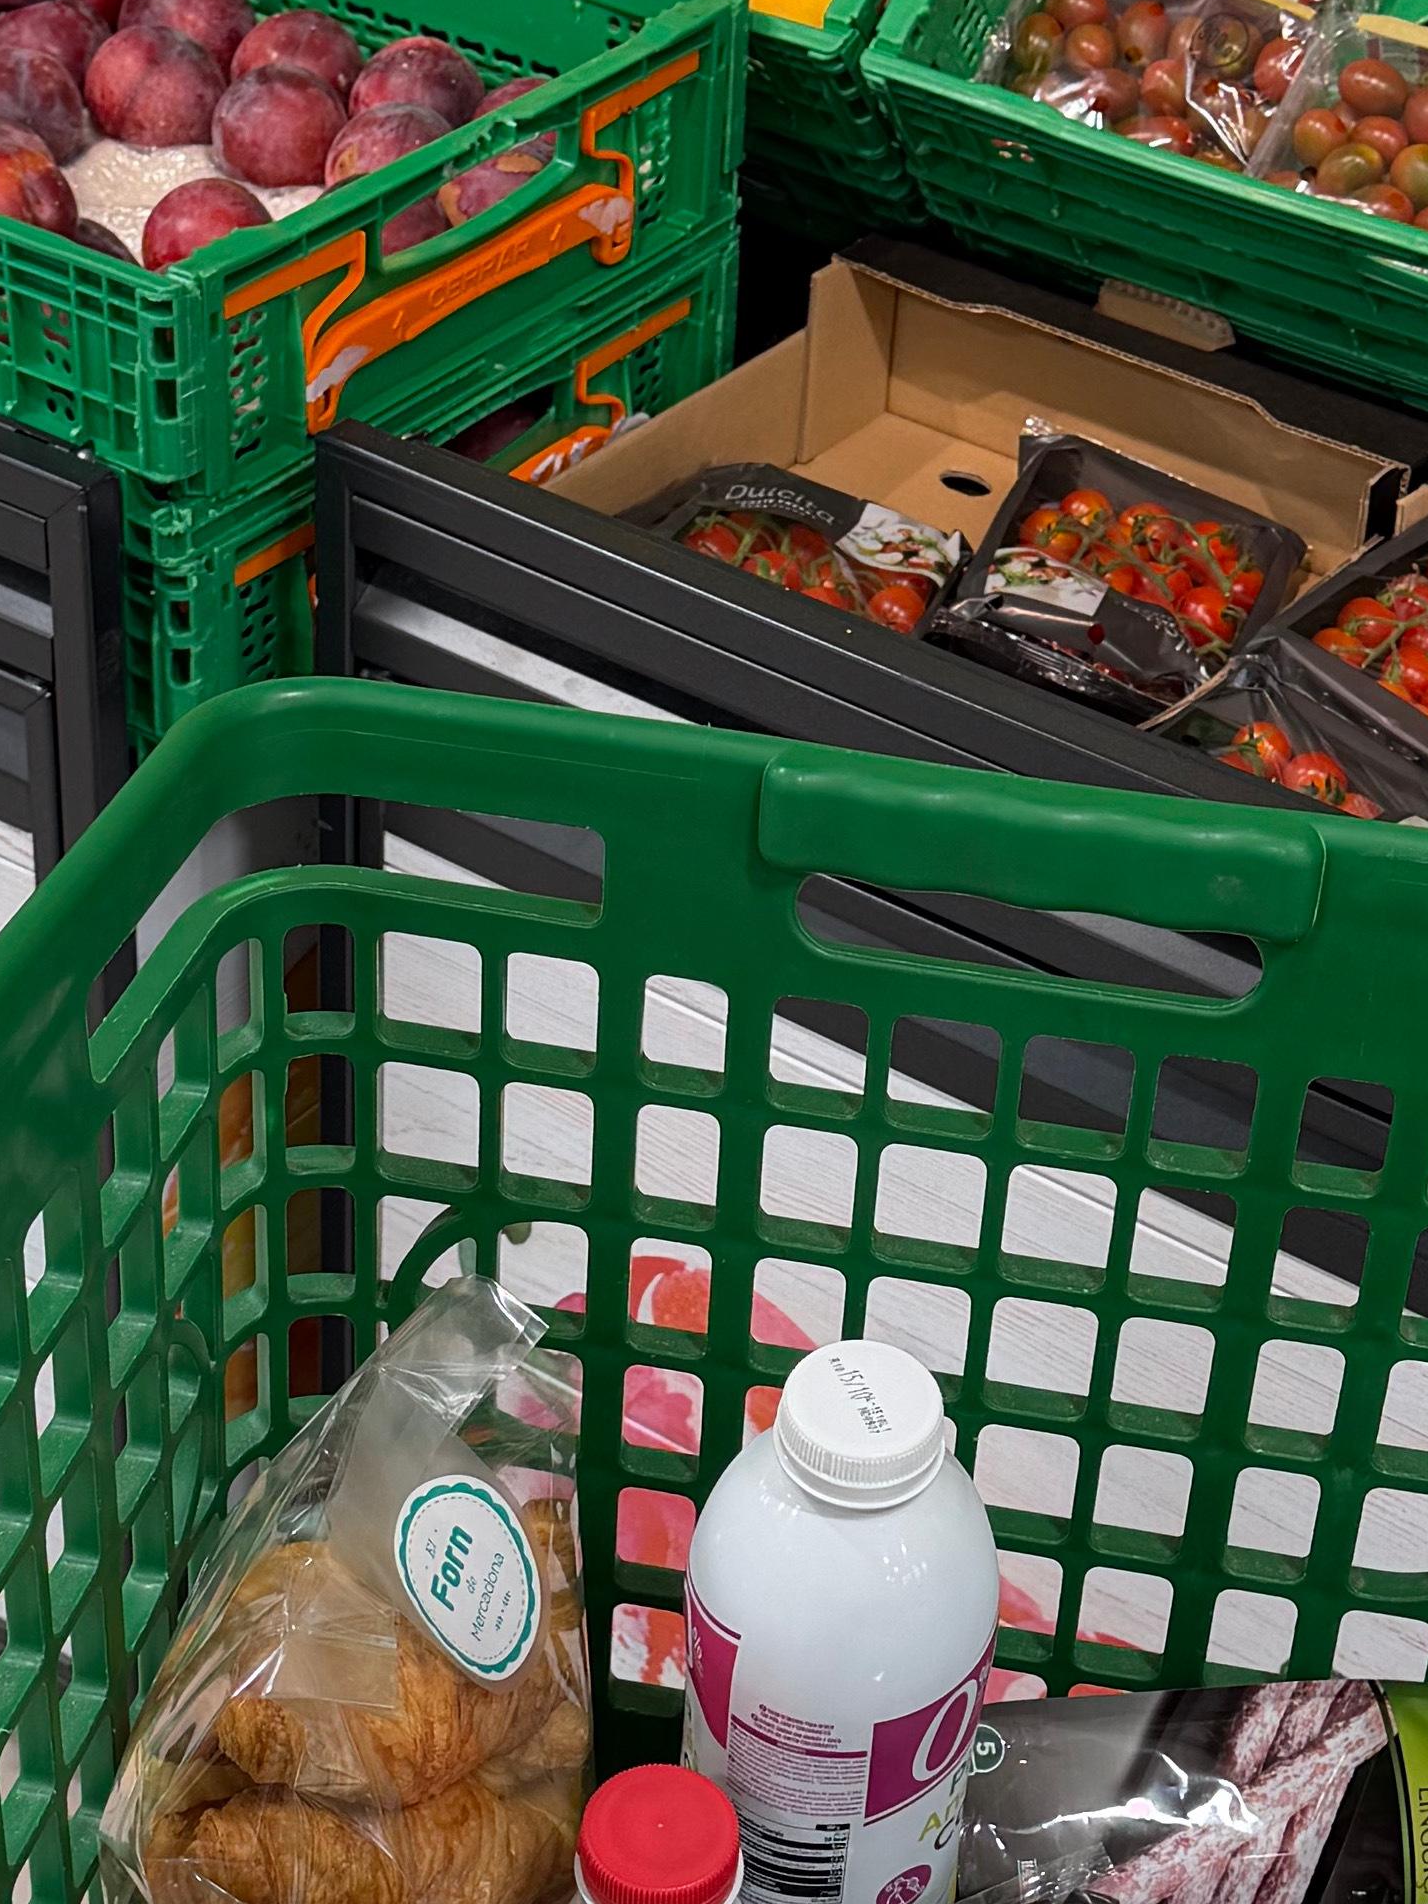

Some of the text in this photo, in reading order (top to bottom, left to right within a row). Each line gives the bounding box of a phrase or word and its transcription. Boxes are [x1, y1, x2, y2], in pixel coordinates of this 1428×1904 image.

[724, 483, 836, 527] Dulcita
[430, 1524, 474, 1612] Forn
[466, 1575, 478, 1595] de
[470, 1552, 506, 1642] Mercadona
[975, 1740, 997, 1757] 5
